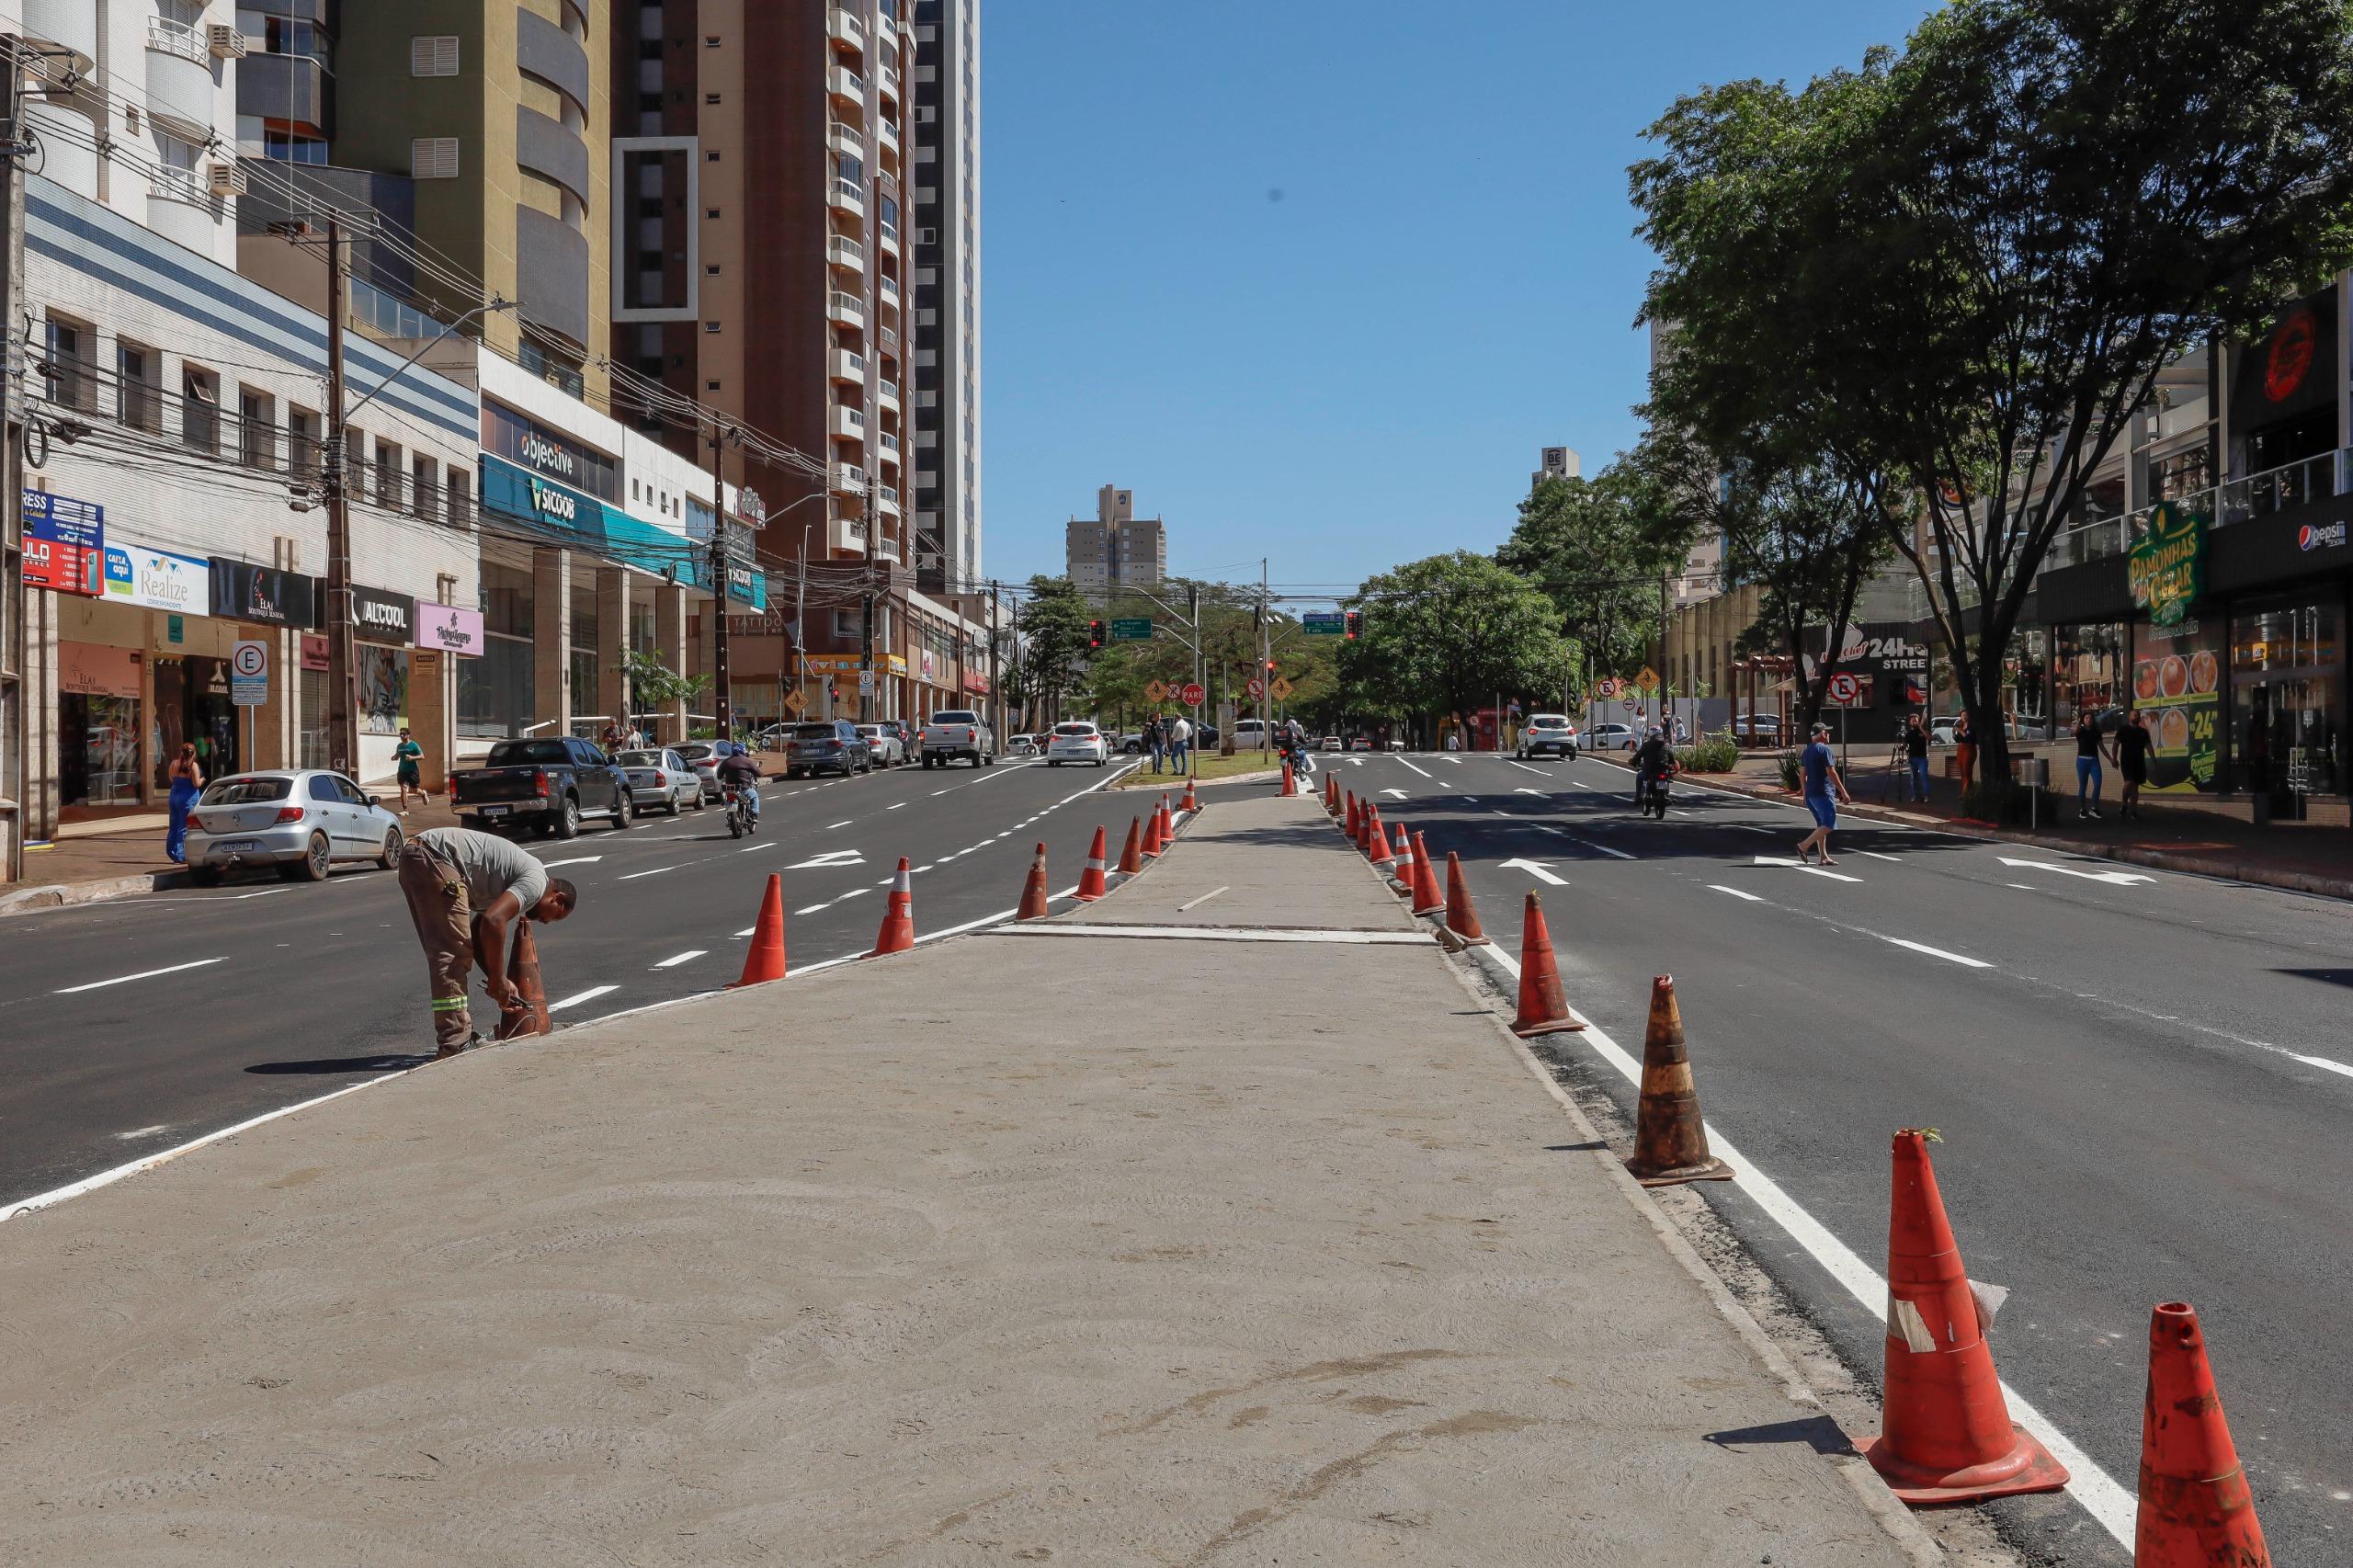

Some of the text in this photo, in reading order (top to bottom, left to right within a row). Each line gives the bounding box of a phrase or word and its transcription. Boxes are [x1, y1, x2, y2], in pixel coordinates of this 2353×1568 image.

[542, 488, 574, 519] SICOOB
[2313, 521, 2339, 546] pepsi
[108, 553, 126, 564] CAIXA
[2131, 532, 2197, 581] PAMONHAS
[112, 563, 129, 578] aqui
[141, 570, 188, 601] Realize
[362, 601, 407, 629] ALCOOL
[734, 618, 782, 628] TATTOO
[245, 652, 254, 669] E
[1882, 659, 1927, 669] STREE
[1184, 691, 1203, 699] PARE
[2195, 710, 2214, 739] 24
